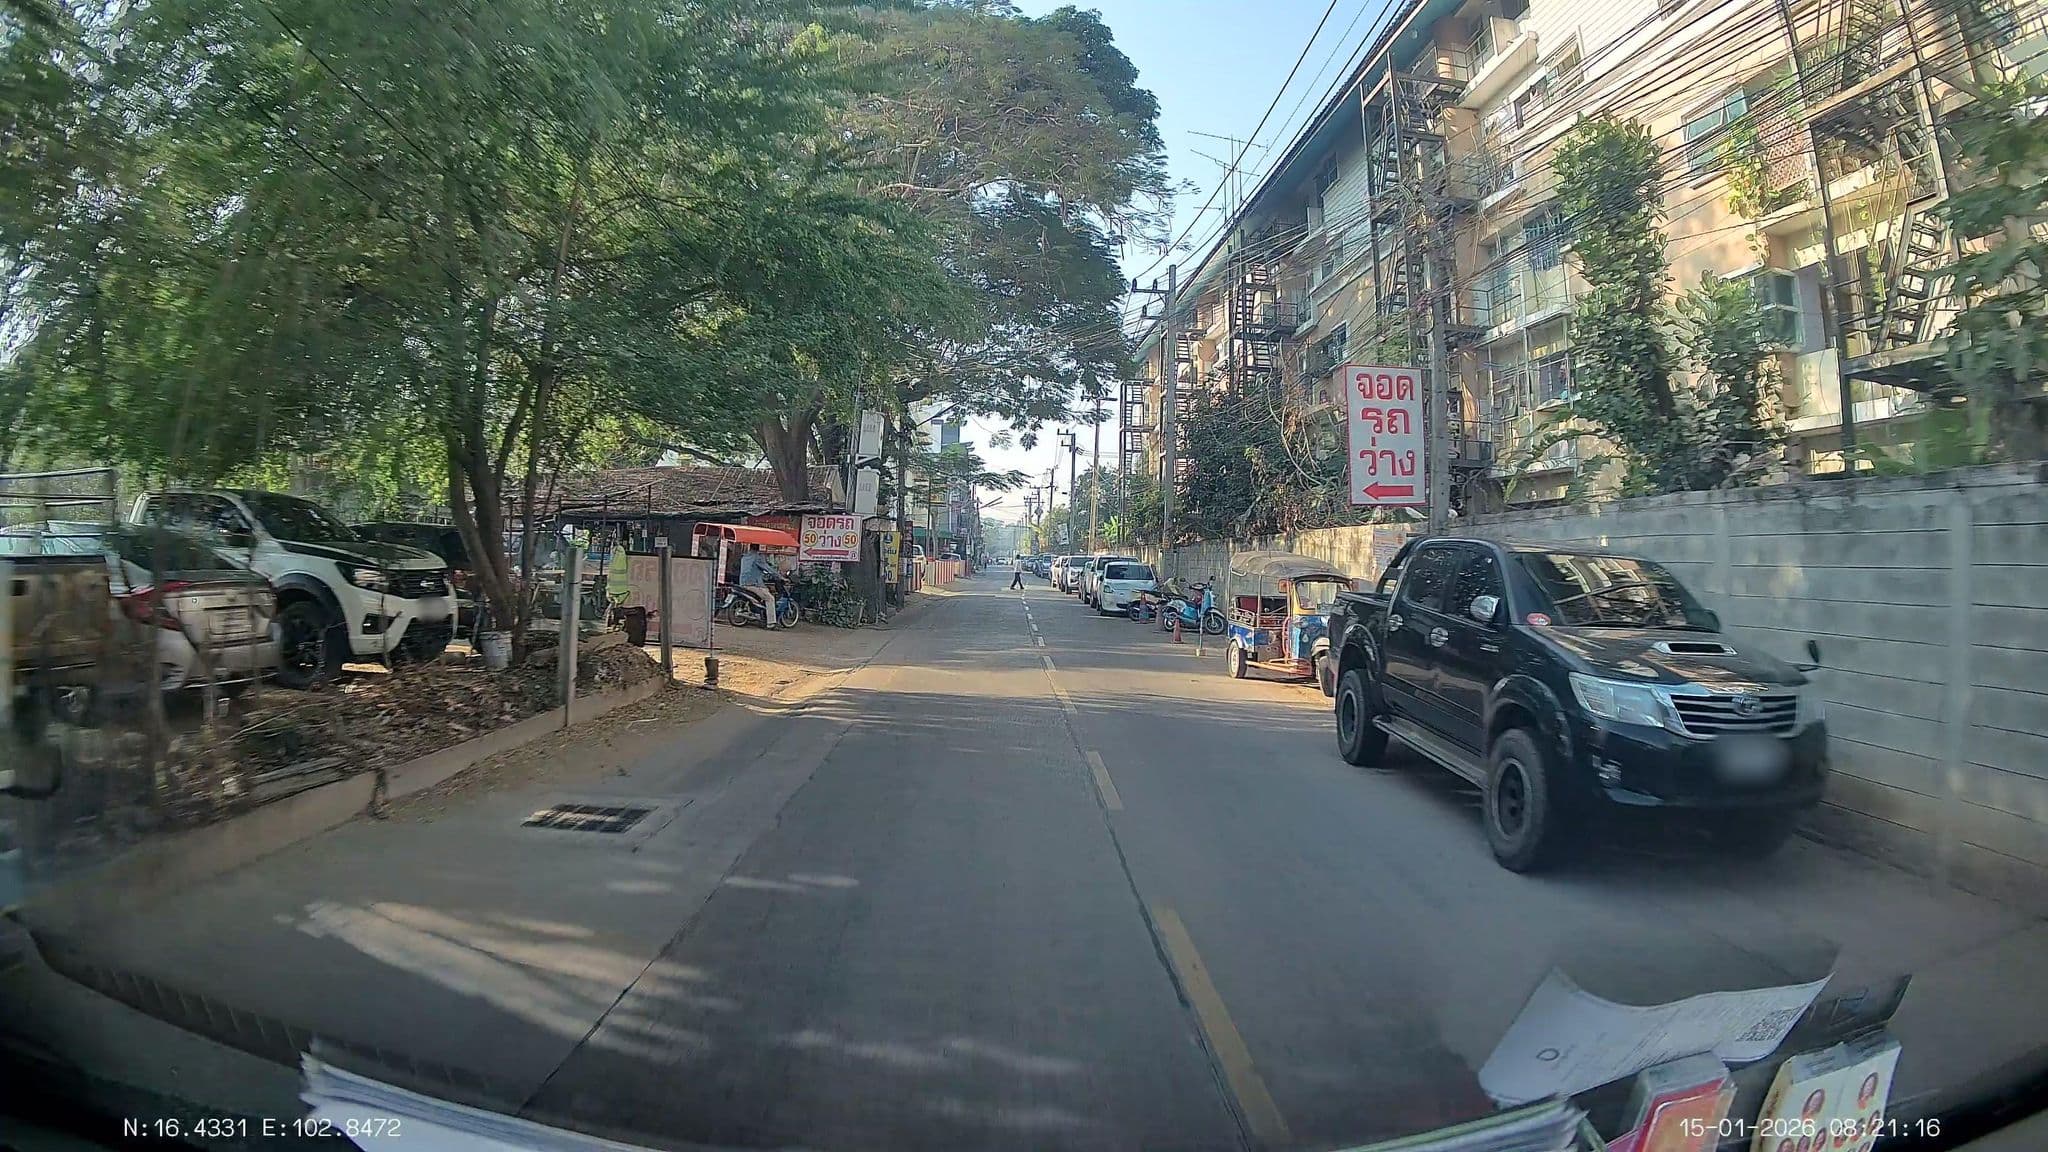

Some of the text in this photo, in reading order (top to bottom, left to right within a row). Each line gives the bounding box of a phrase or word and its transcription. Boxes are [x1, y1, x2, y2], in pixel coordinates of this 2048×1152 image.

[1356, 373, 1414, 401] จอด
[1361, 407, 1410, 434] รถ
[1359, 436, 1415, 476] ว่าง
[808, 517, 854, 530] จอดรถ
[804, 530, 857, 547] 50 ว่าง 50
